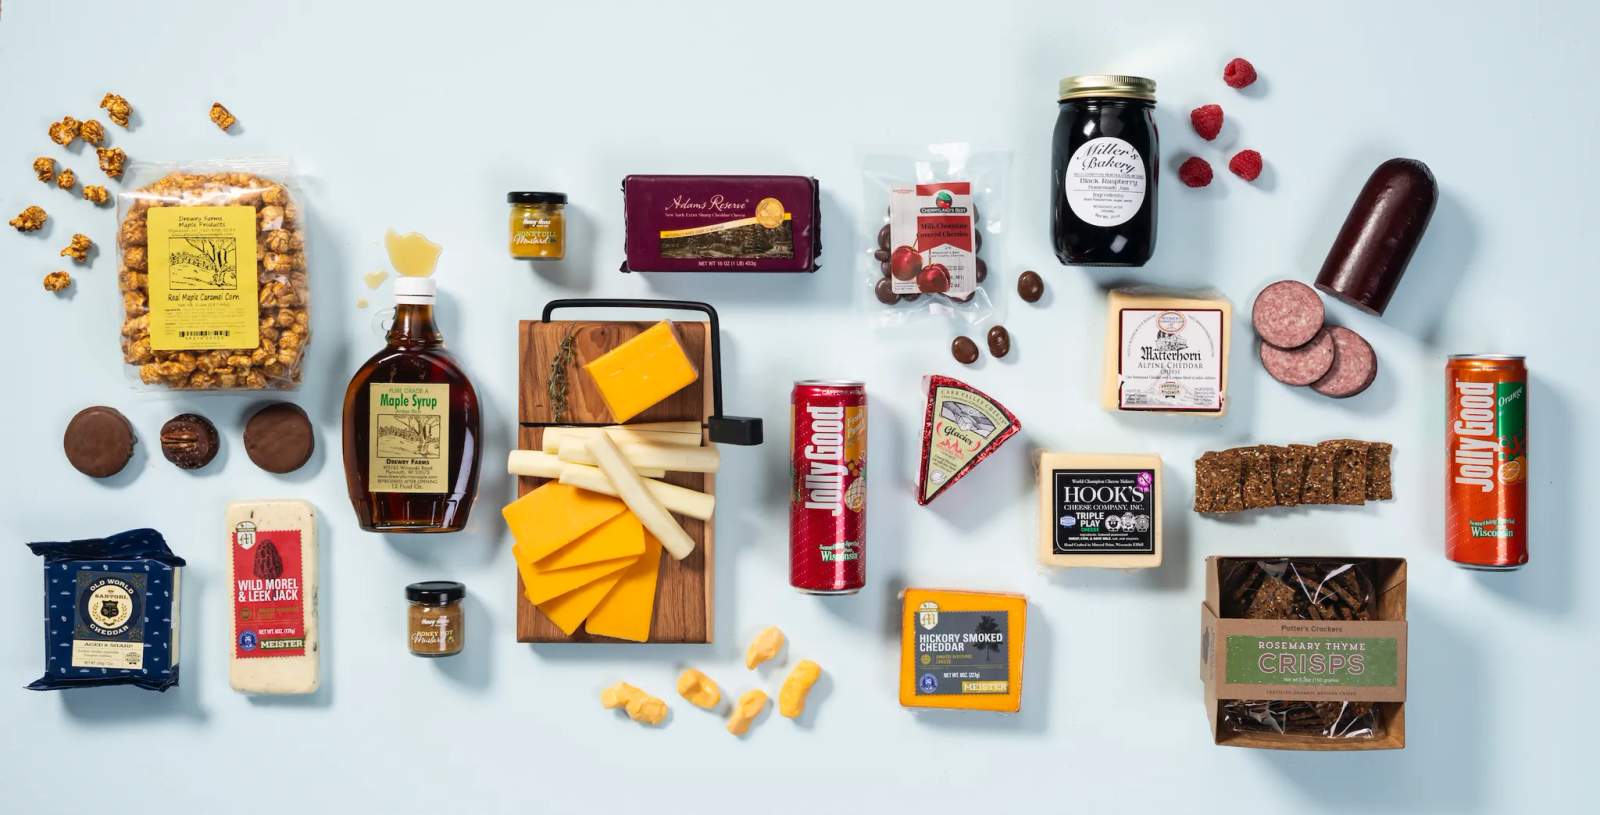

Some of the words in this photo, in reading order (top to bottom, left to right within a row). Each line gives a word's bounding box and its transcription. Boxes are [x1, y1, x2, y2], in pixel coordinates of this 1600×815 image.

[1077, 143, 1138, 160] Miller's
[1082, 156, 1136, 173] Bakery
[665, 194, 706, 210] Adams
[708, 194, 746, 211] Reserve
[168, 294, 180, 302] Real
[182, 294, 198, 302] Maple
[200, 293, 224, 301] Caramel
[1140, 346, 1202, 360] Matterhorn
[380, 394, 409, 409] Maple
[412, 394, 438, 410] Syrup
[1498, 386, 1523, 407] Orange
[944, 426, 974, 446] Glacier
[1064, 486, 1144, 503] HOOK'S
[1076, 512, 1104, 520] TRIPLE
[1080, 520, 1100, 528] PLAY
[820, 550, 858, 562] Wisconsin
[90, 580, 105, 591] OLD
[107, 579, 134, 594] WORLD
[238, 579, 263, 590] WILD
[266, 578, 299, 590] MOREL
[238, 591, 246, 602] &
[249, 591, 271, 602] LEEK
[273, 589, 298, 601] JACK
[90, 624, 129, 635] CHEDDAR
[261, 640, 303, 648] MEISTER
[920, 634, 960, 643] HICKORY
[963, 633, 1003, 642] SMOKED
[920, 643, 964, 652] CHEDDAR
[1258, 641, 1321, 650] ROSEMARY
[1326, 642, 1366, 651] THYME
[1258, 652, 1365, 675] CRISPS
[964, 683, 1007, 691] MEISTER
